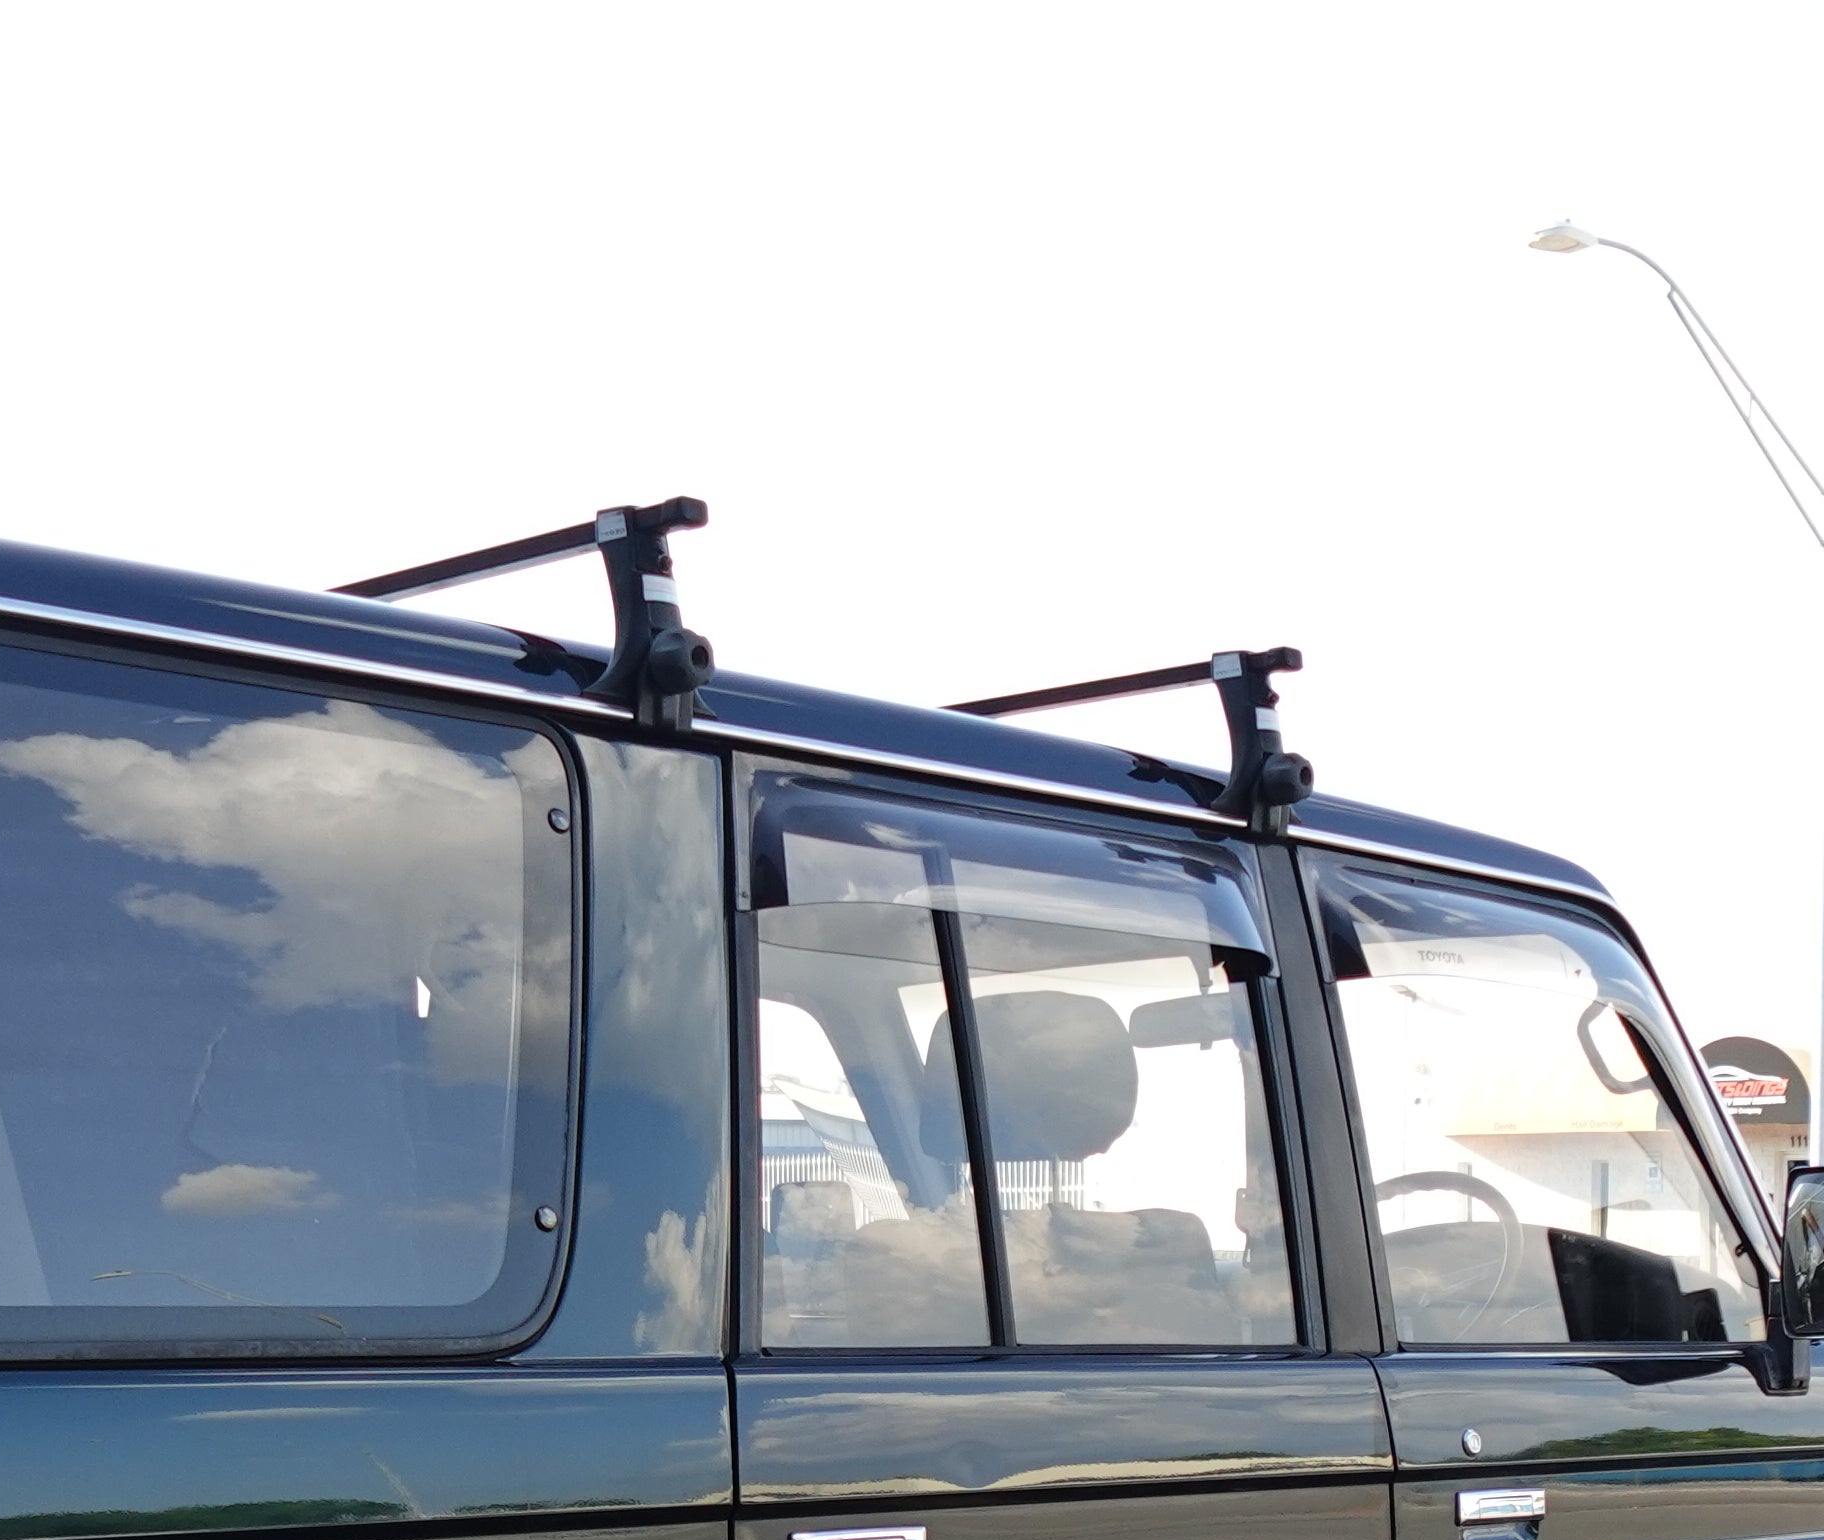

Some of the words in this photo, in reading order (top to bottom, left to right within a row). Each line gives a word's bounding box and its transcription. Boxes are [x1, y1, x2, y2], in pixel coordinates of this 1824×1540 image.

[1417, 950, 1464, 965] TOYOTA
[1715, 1078, 1788, 1098] TS&DINGS
[1571, 1119, 1589, 1129] Hail
